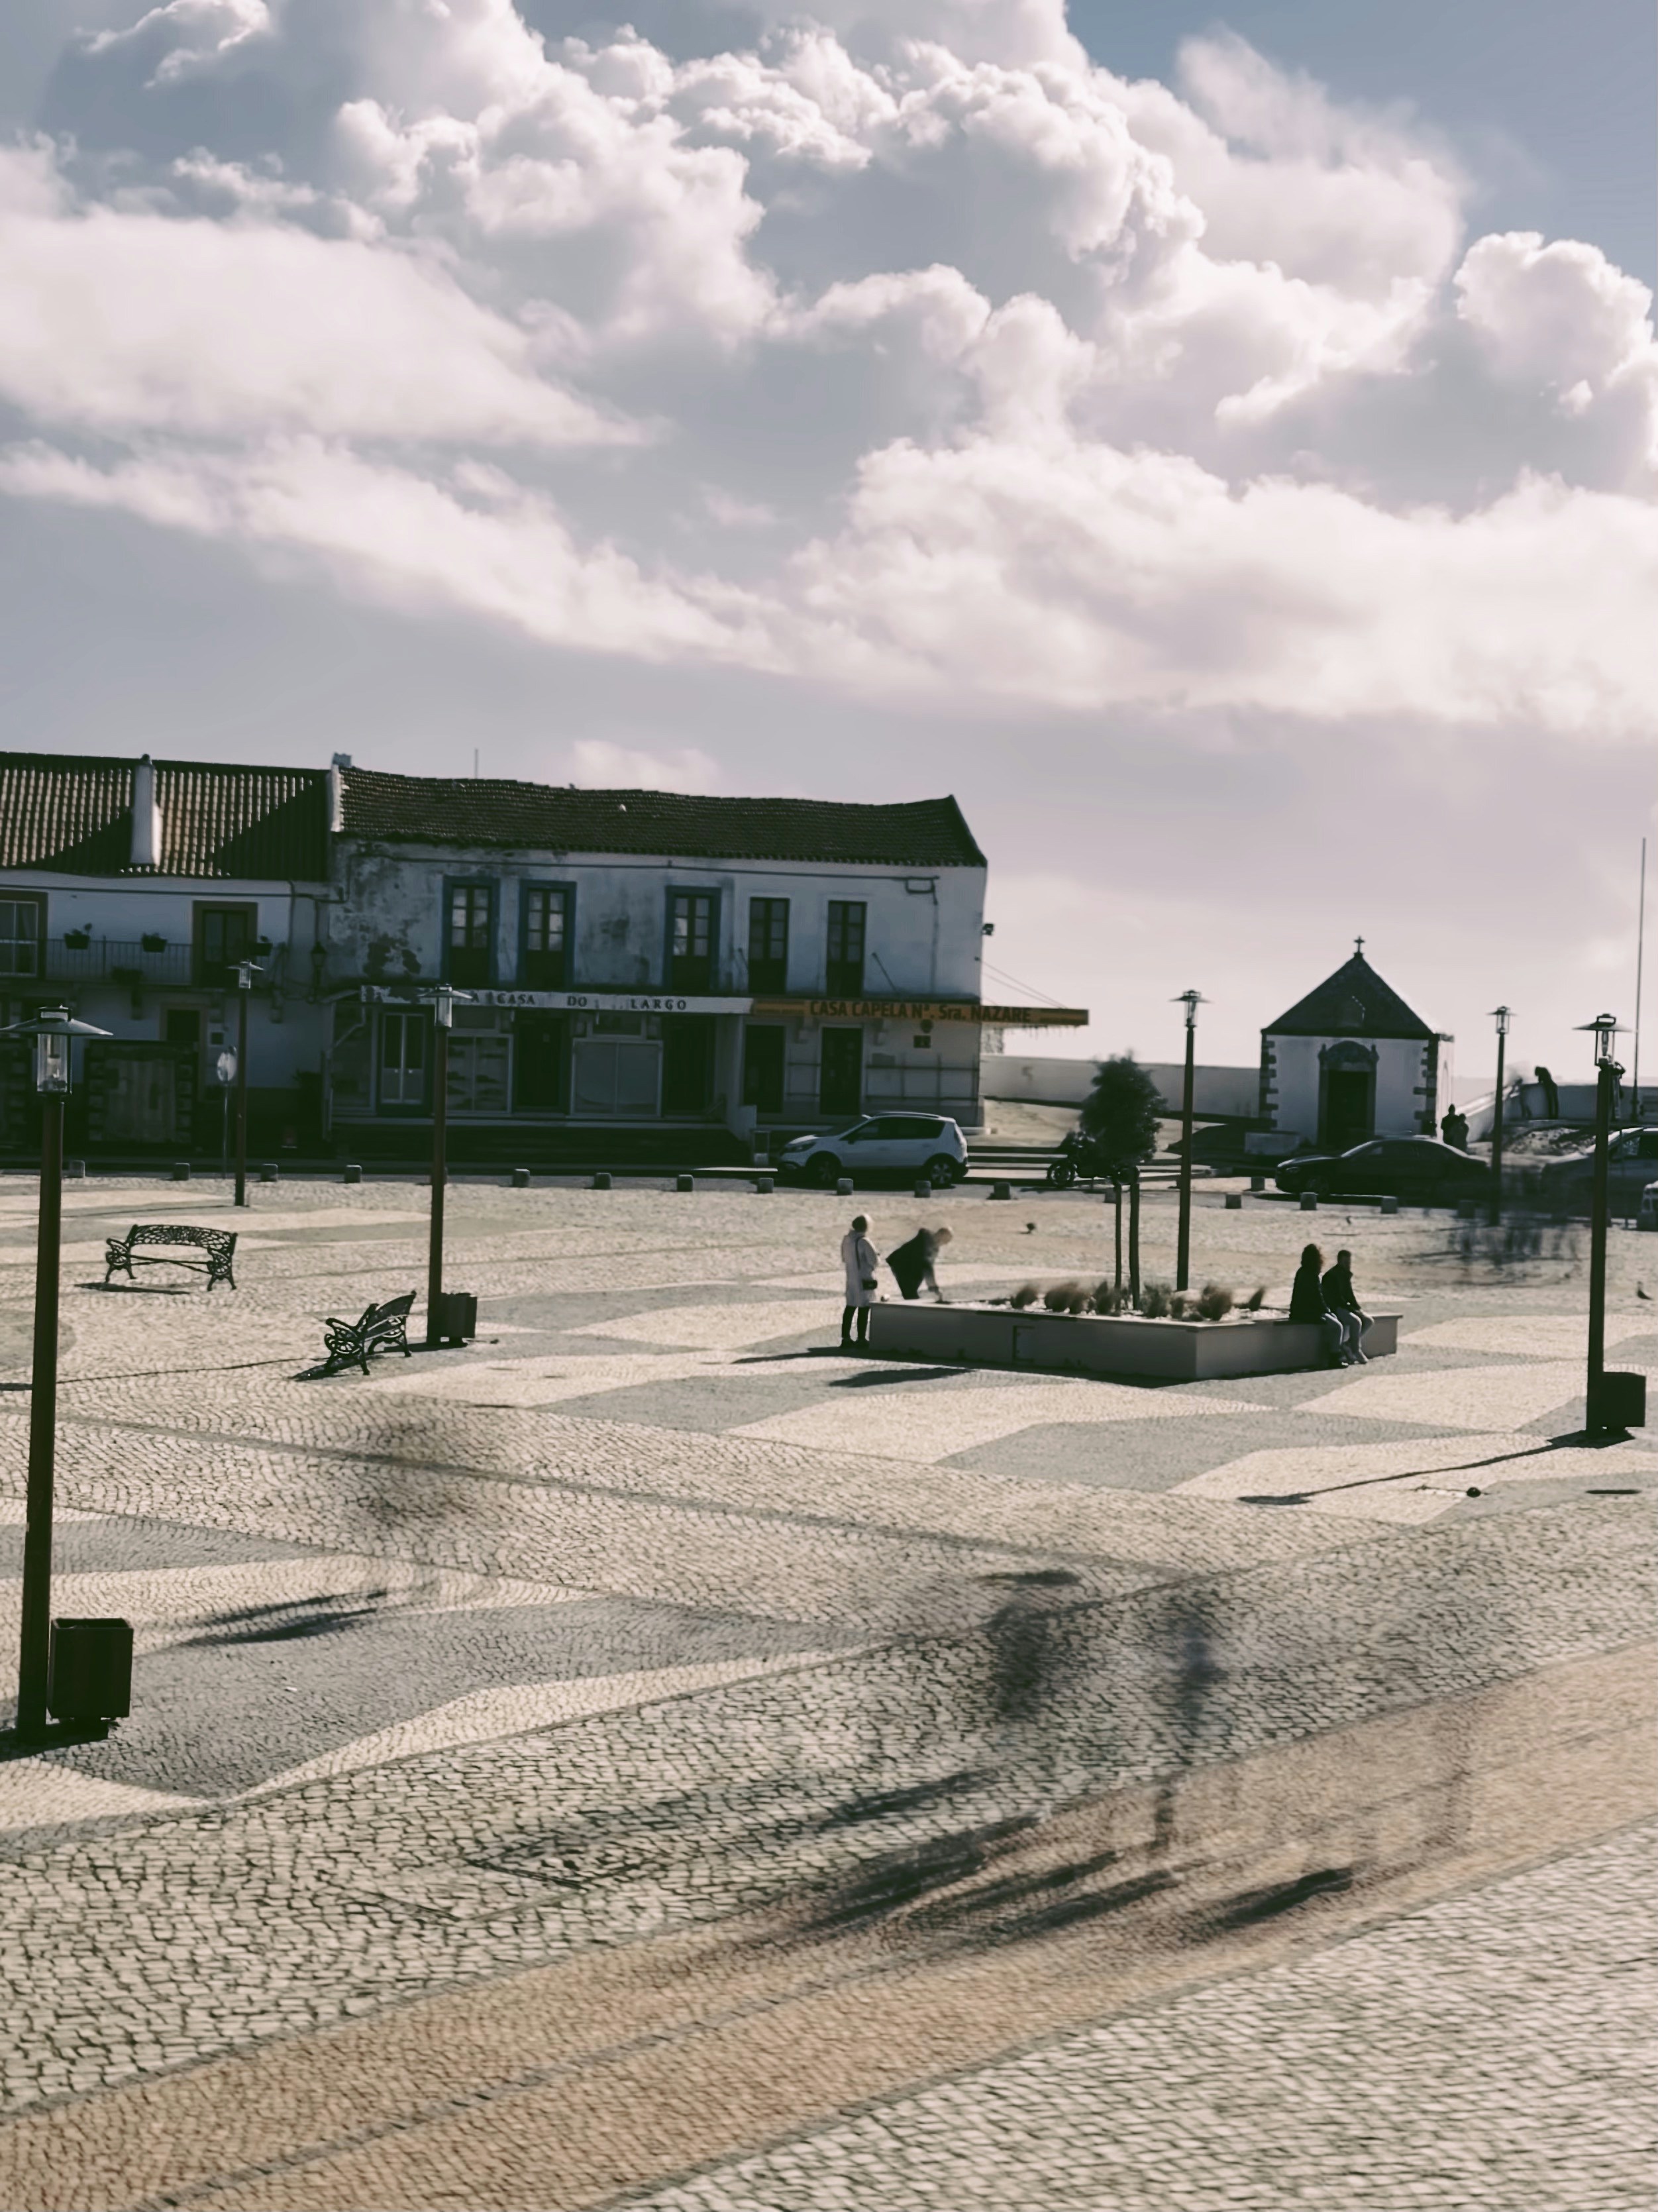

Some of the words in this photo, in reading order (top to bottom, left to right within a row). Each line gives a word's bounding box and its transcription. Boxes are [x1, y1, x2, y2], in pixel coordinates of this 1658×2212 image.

[497, 992, 535, 1005] CASA
[567, 996, 588, 1007] DO
[631, 998, 687, 1010] LARGO
[810, 1000, 848, 1016] CASA
[852, 1002, 908, 1018] CAPELA
[939, 1005, 966, 1020] Sra.
